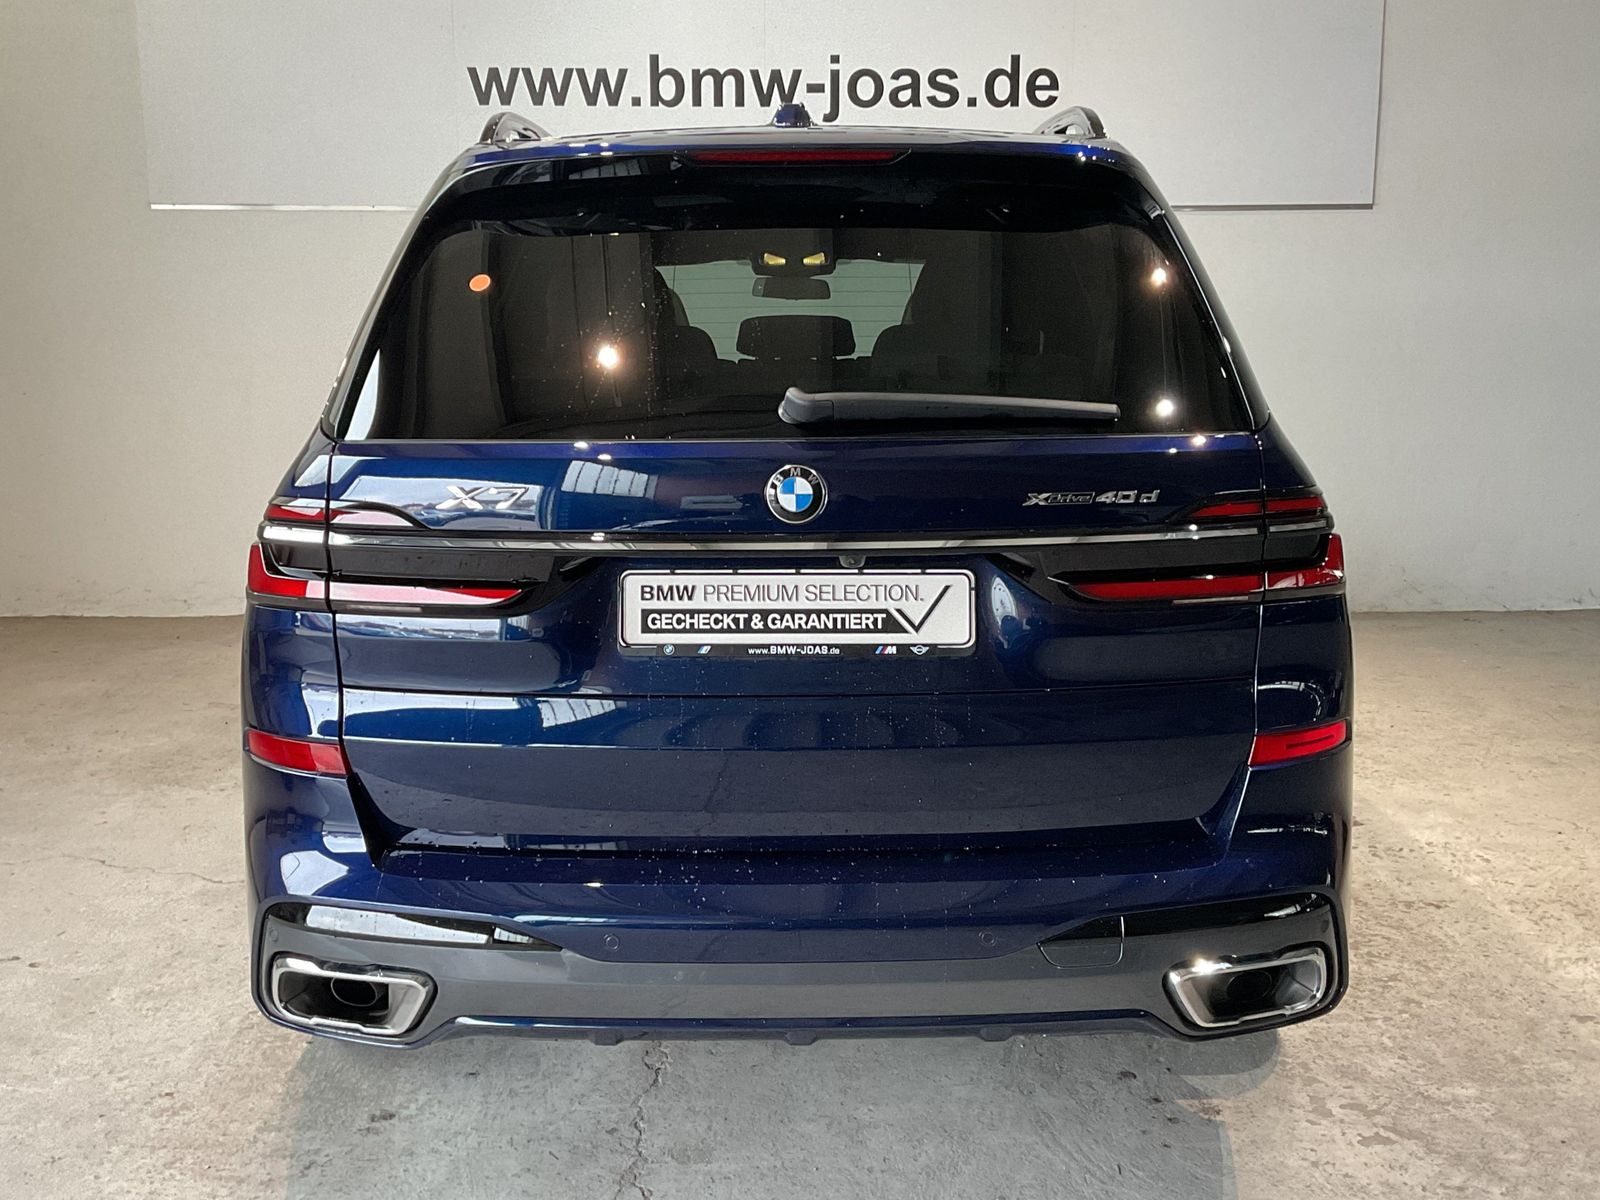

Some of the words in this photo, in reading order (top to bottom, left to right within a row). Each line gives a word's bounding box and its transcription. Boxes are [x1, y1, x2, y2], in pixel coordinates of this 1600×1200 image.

[467, 54, 1059, 121] www.bmw-joas.de
[773, 467, 819, 486] BMW
[435, 486, 529, 509] X7
[640, 585, 695, 602] BMW
[703, 585, 799, 602] PREMIUM
[804, 585, 924, 602] SELECTION.
[647, 613, 748, 630] GECHECKT
[751, 613, 764, 629] &
[767, 613, 886, 630] GARANTIERT
[747, 645, 840, 655] www.BMW-JOAS.de
